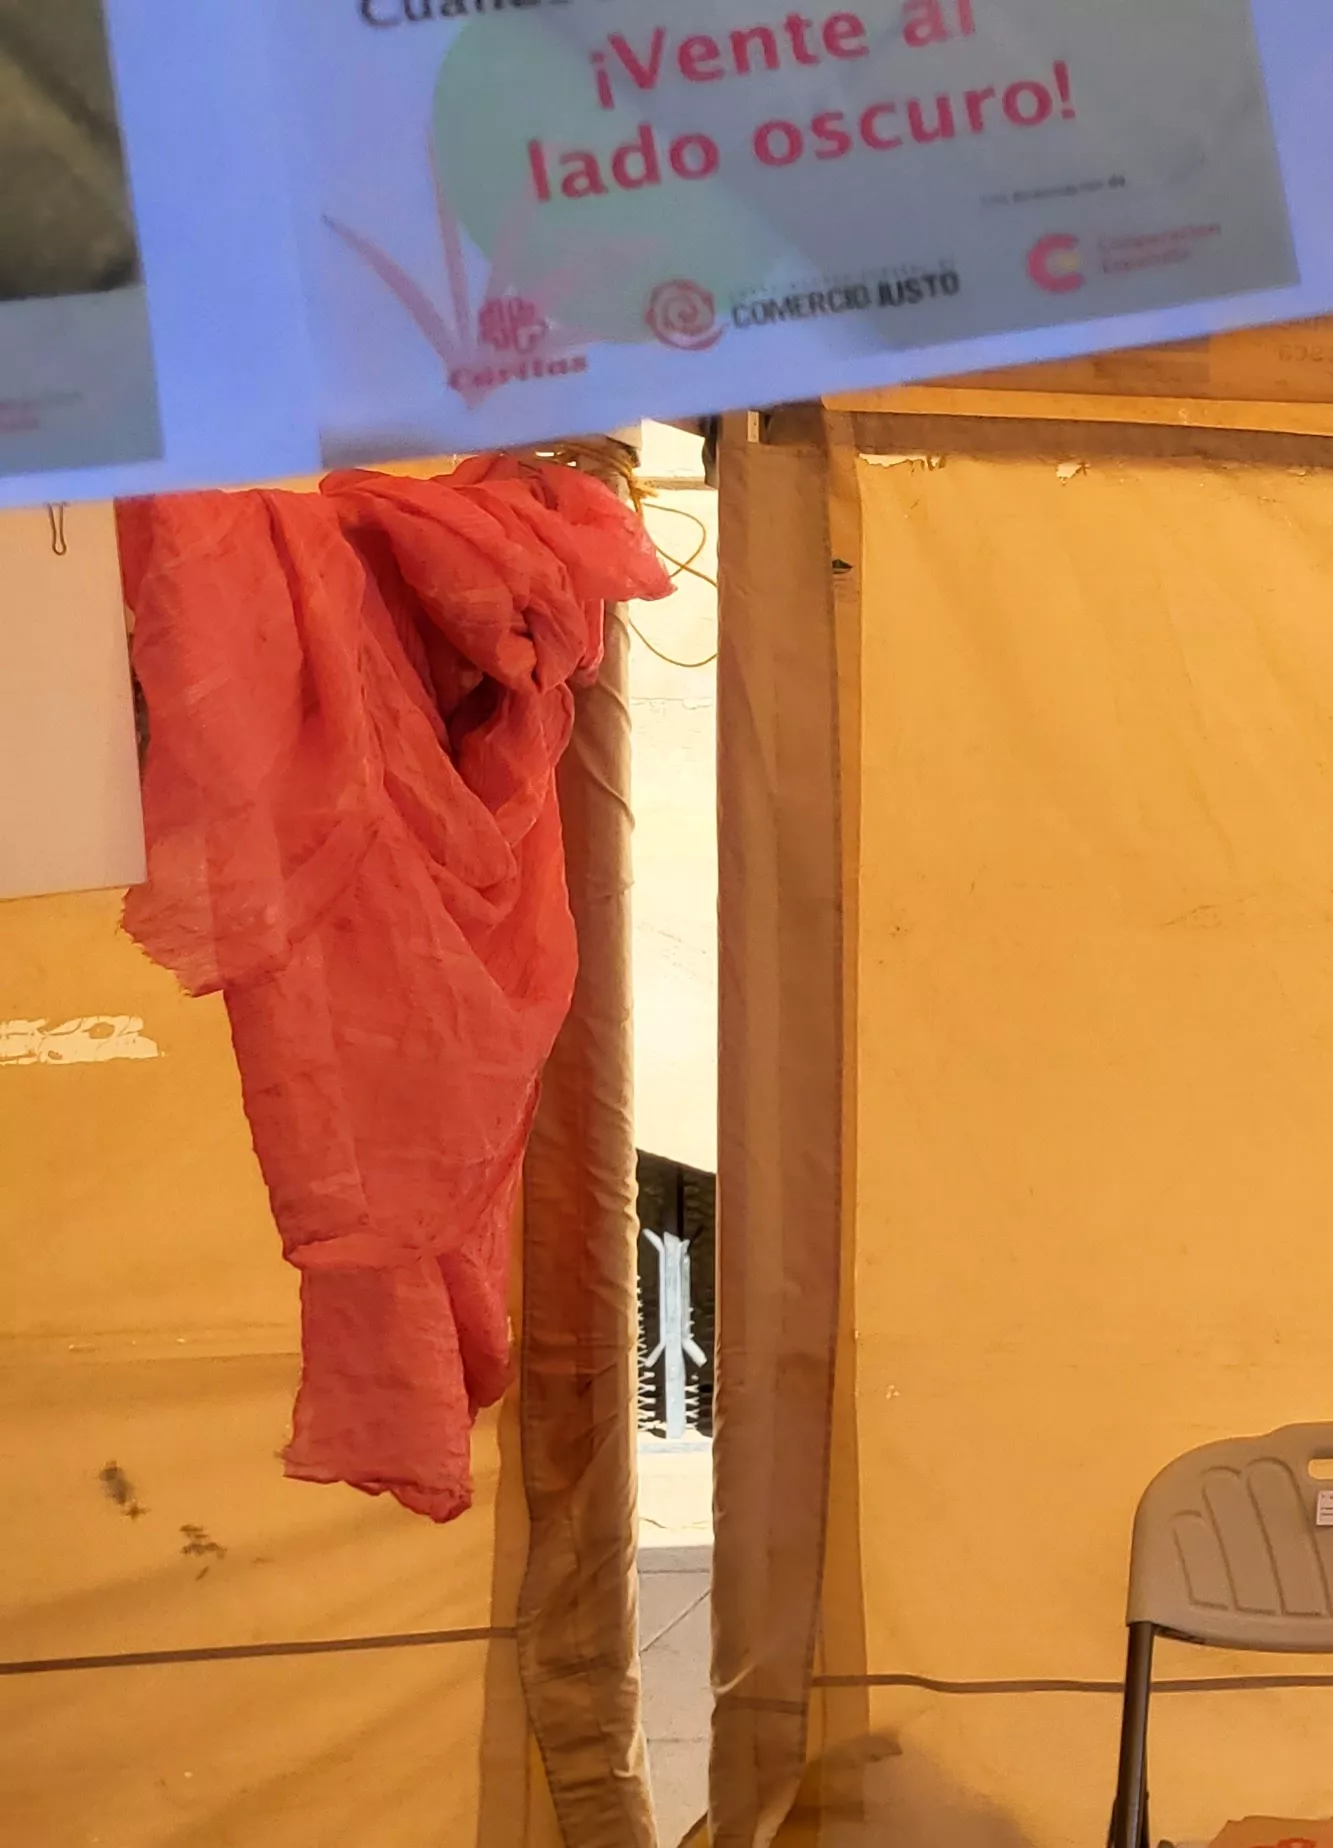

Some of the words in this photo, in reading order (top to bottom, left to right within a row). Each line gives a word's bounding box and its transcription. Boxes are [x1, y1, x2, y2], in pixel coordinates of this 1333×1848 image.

[590, 10, 870, 110] ¡Vente
[528, 122, 721, 203] lado
[752, 60, 1079, 168] oscuro!
[731, 284, 875, 329] COMERCIO
[877, 269, 961, 308] JUSTO
